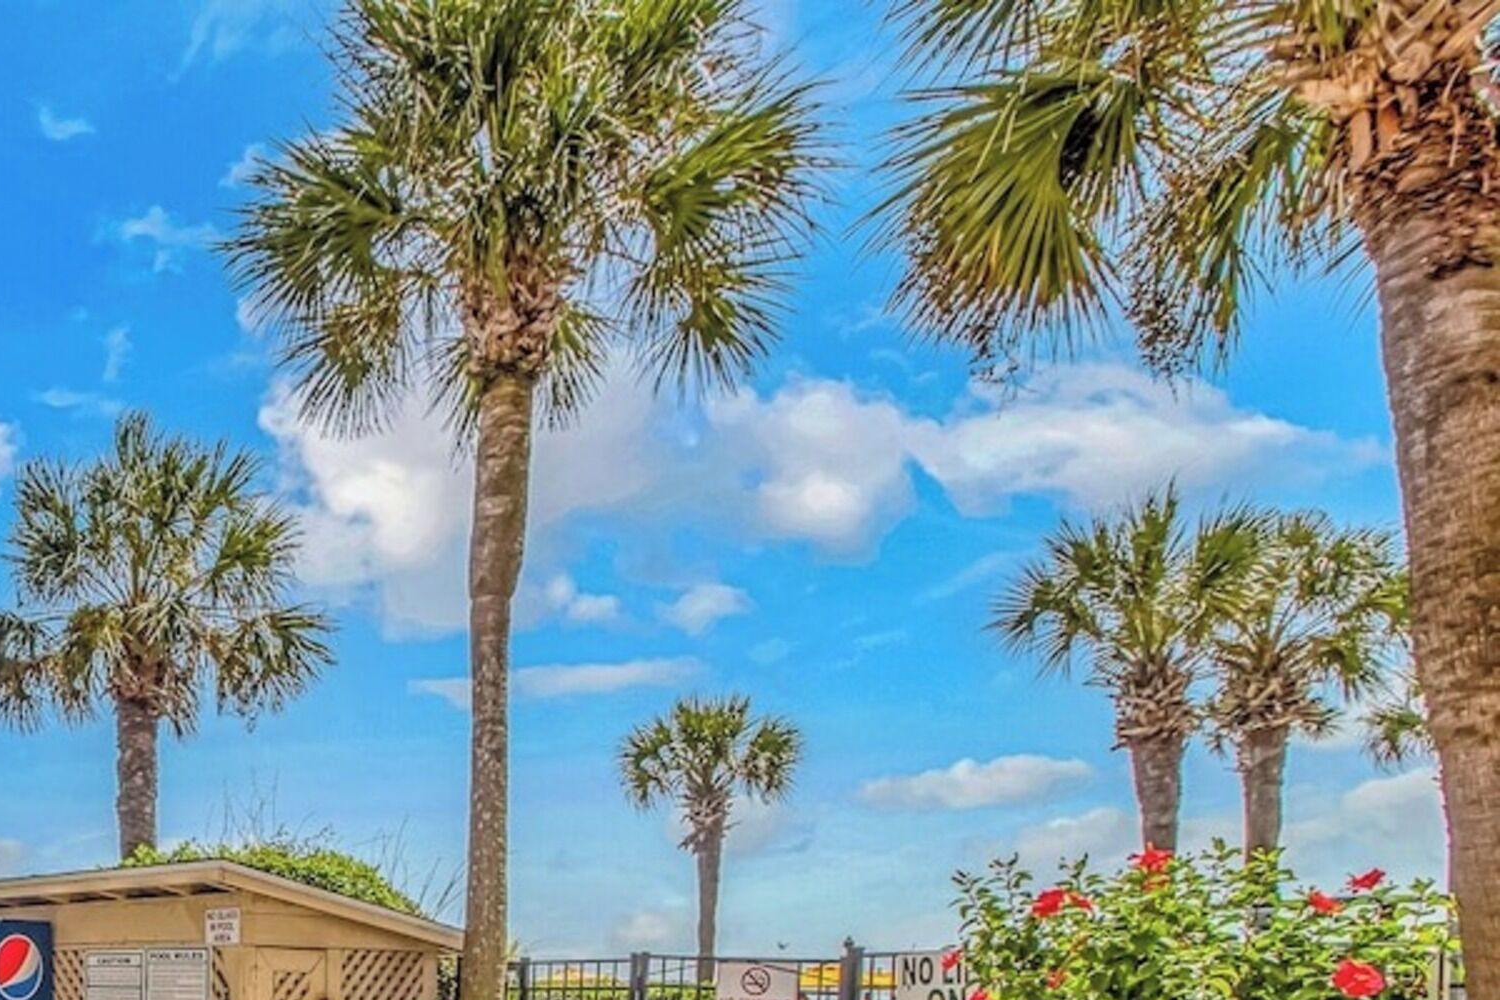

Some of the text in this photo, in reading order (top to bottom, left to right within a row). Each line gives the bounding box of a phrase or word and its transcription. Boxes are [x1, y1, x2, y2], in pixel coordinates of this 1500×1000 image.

[149, 951, 203, 960] POOL RULES
[903, 957, 934, 985] NO
